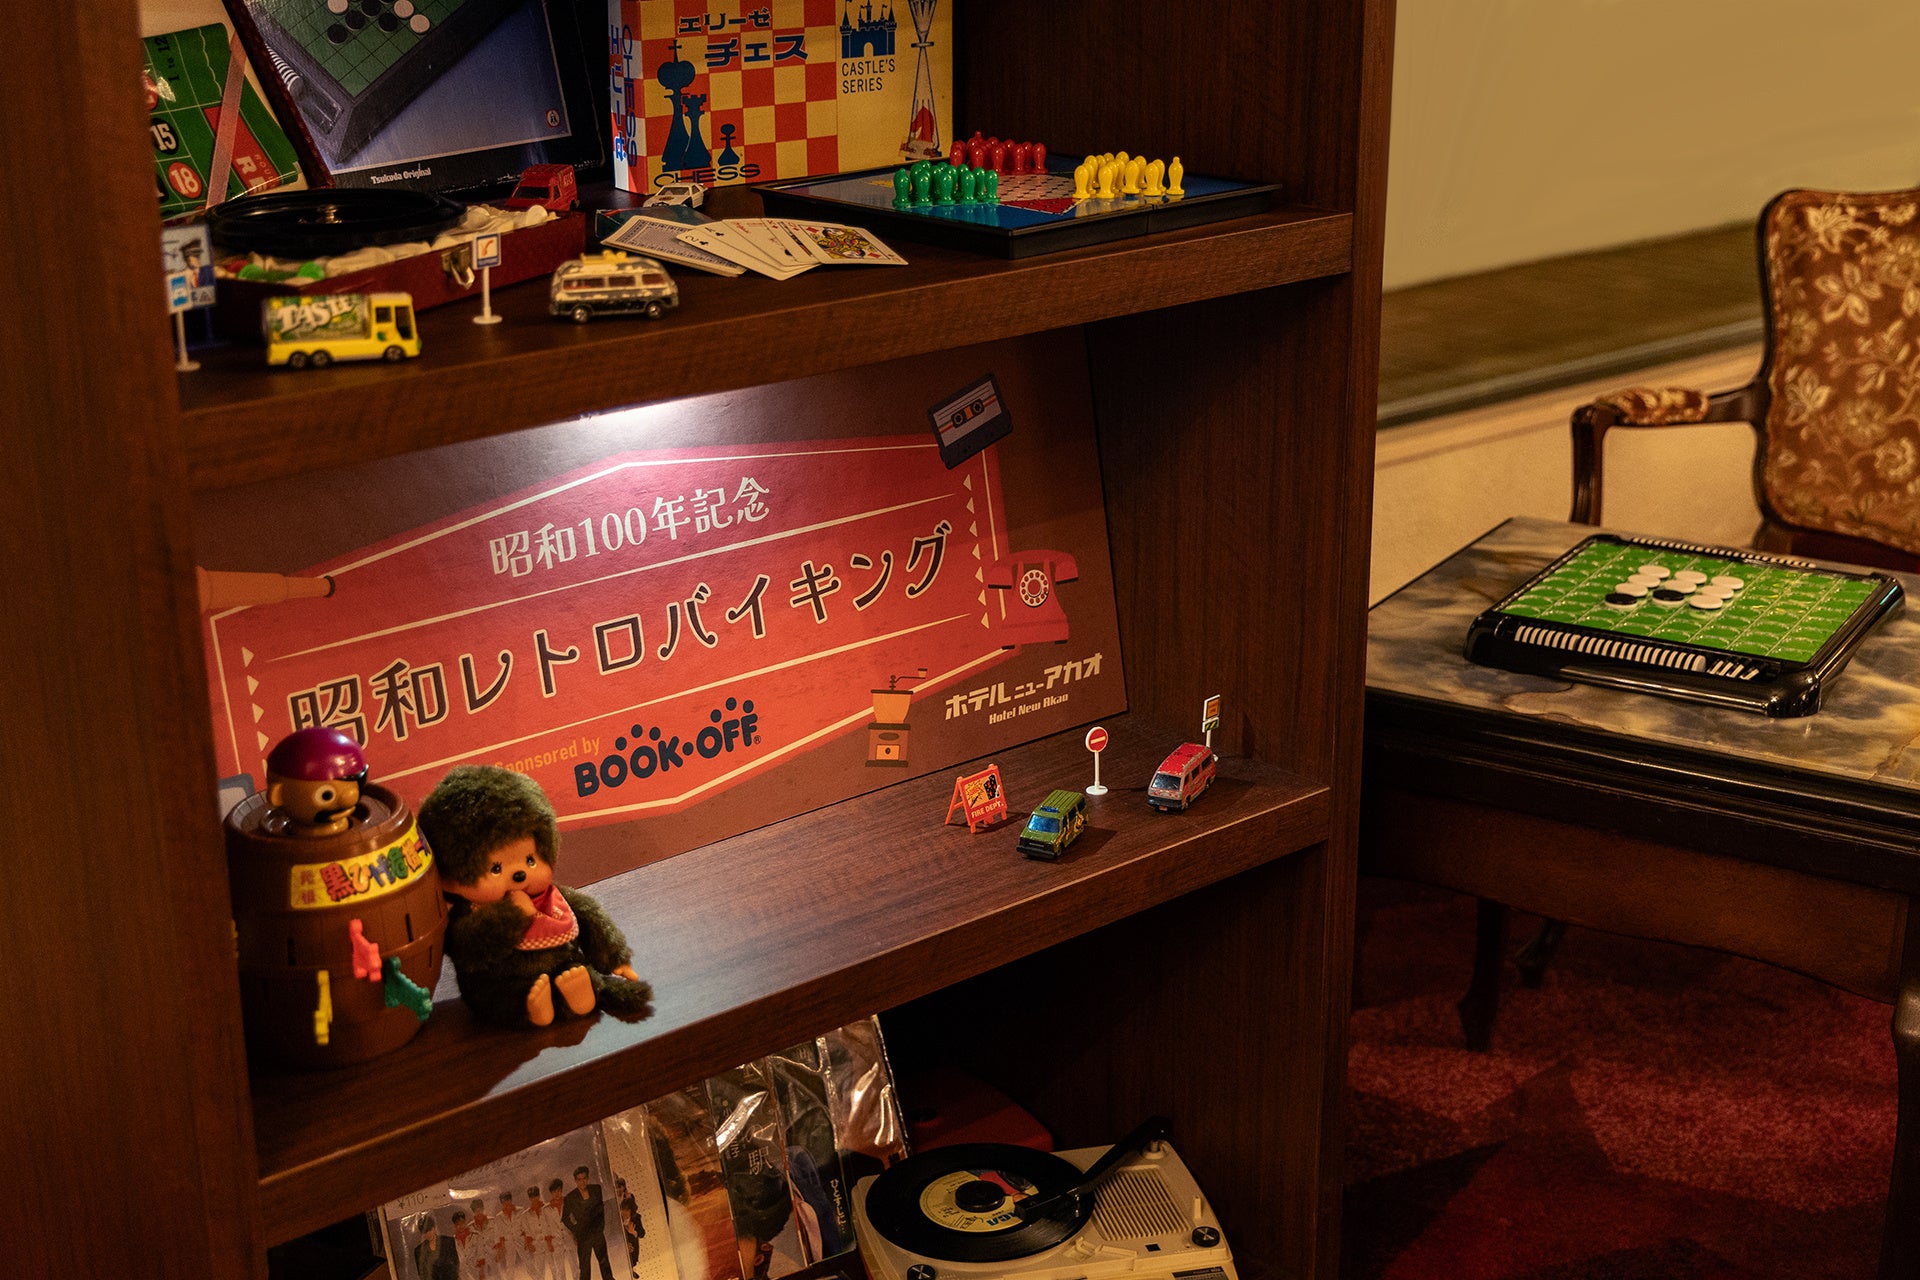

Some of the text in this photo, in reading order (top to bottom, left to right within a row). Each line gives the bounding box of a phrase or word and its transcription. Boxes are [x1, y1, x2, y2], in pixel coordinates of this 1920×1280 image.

[678, 8, 771, 33] エリーゼ
[704, 33, 808, 68] チェス
[841, 59, 896, 77] CASTLE'S
[622, 24, 638, 168] CHESS
[842, 77, 883, 94] SERIES
[150, 123, 177, 151] 15
[171, 167, 198, 195] 18
[370, 167, 432, 185] Tsukuda Original
[653, 163, 762, 187] CHESS
[489, 476, 770, 578] 昭和100年記念
[289, 519, 951, 749] 昭和レトロバイキング
[988, 693, 1069, 725] Hotel New Akao
[582, 737, 600, 756] by
[971, 808, 985, 819] FIRE
